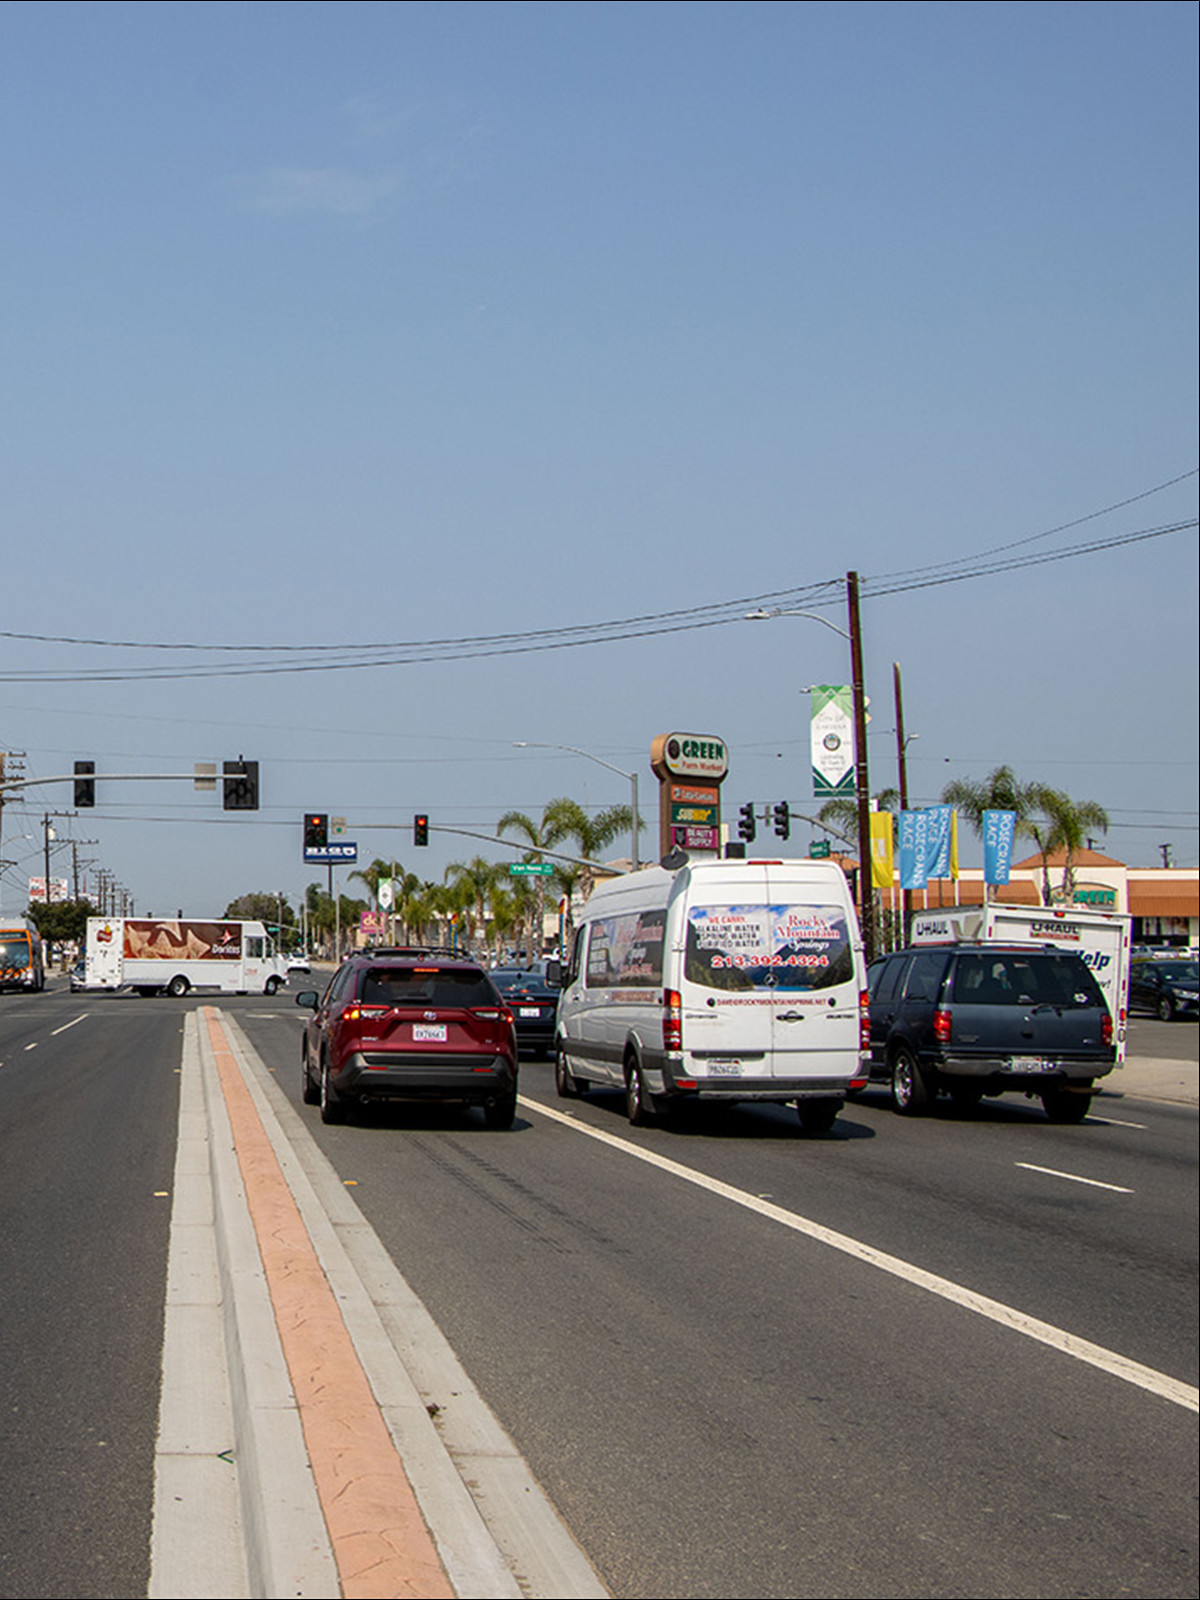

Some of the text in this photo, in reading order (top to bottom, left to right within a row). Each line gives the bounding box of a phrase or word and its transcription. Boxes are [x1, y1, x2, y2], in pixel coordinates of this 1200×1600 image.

[682, 740, 724, 760] GREEN
[676, 808, 712, 822] SUBWAY
[902, 814, 914, 850] PLACE
[987, 812, 999, 847] PLACE
[912, 814, 927, 885] ROSECRANS
[995, 813, 1012, 880] ROSECRANS
[788, 914, 827, 929] Rocky
[916, 920, 948, 936] U-HAUL
[1031, 922, 1079, 934] U-HAUL
[777, 926, 840, 938] Mountain
[211, 943, 240, 955] Doritos
[711, 955, 829, 968] 213.392.4324
